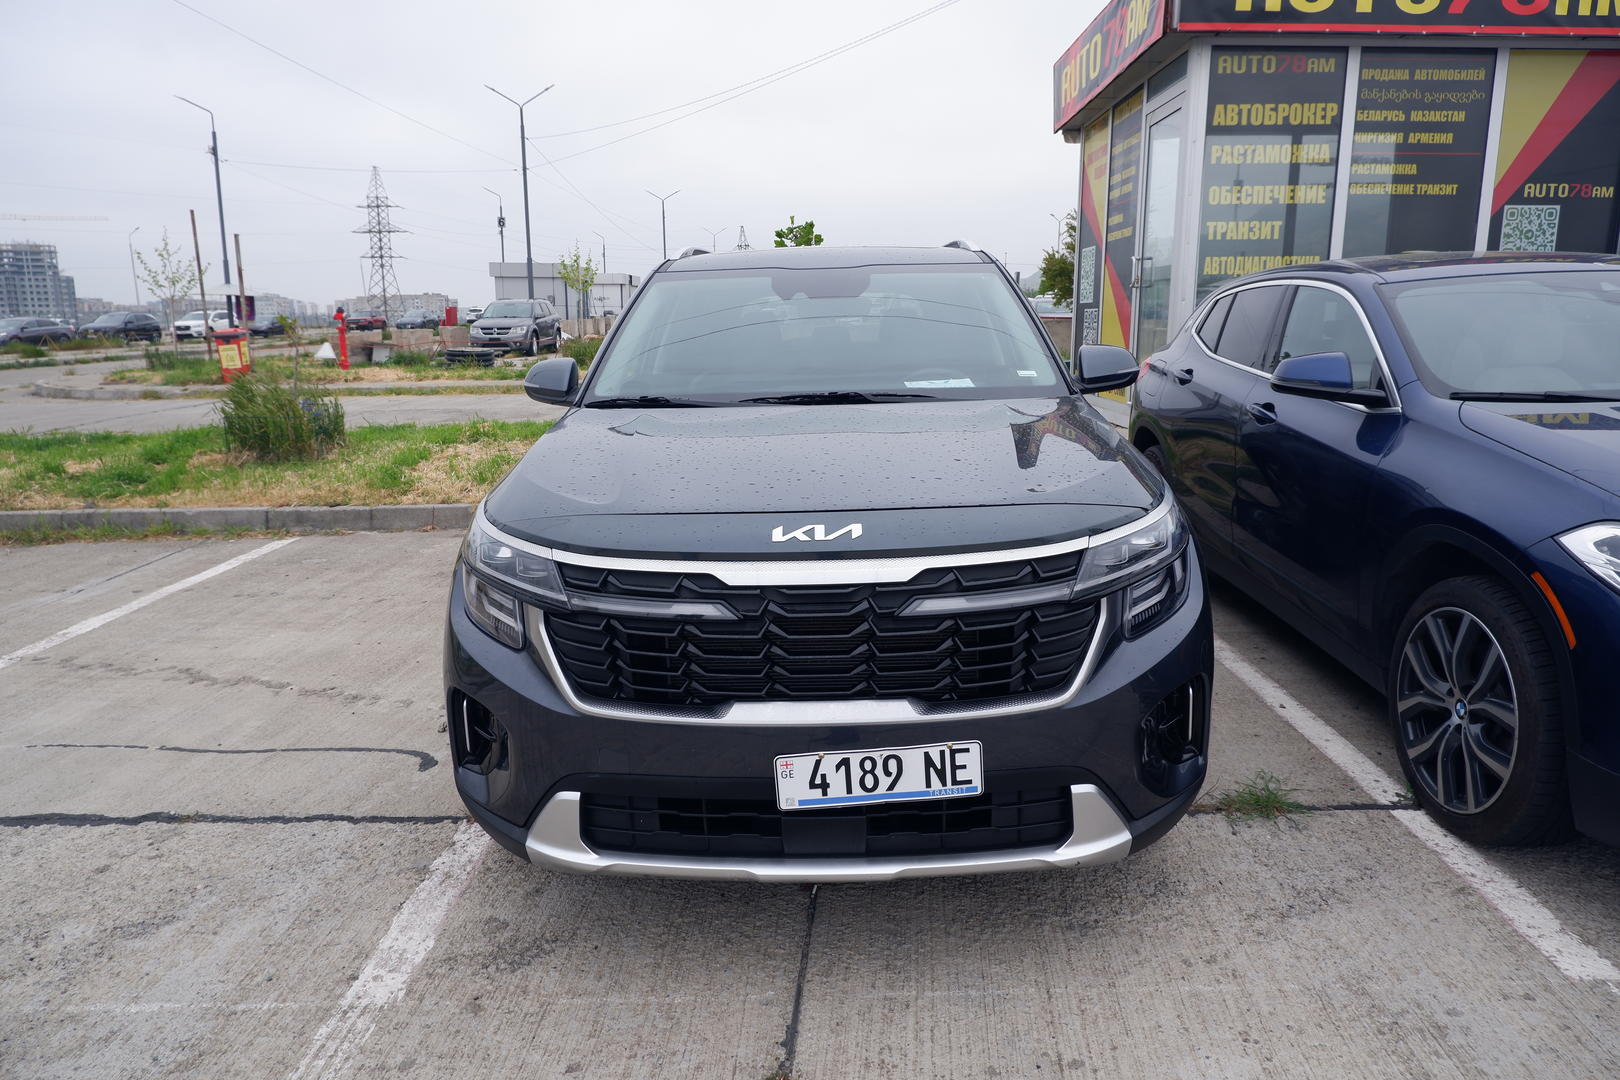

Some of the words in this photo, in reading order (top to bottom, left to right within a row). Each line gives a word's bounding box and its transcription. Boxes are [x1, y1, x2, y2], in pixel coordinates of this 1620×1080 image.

[1217, 54, 1336, 74] AUTO78AM
[1361, 68, 1410, 82] ПРОДАЖА
[1414, 68, 1486, 81] АВТОМОБИЛЕЙ
[1212, 103, 1338, 126] АВТОБРОКЕР
[1356, 110, 1405, 121] БЕЛАРУСЬ
[1410, 110, 1466, 122] КАЗАХСТАН
[1354, 132, 1404, 144] КИРГИЗИЯ
[1407, 132, 1454, 144] АРМЕНИЯ
[1211, 144, 1330, 165] РАСТАМОЖКА
[1351, 163, 1417, 175] РАСТАМОЖКА
[1208, 184, 1327, 205] ОБЕСПЕЧЕНИЕ
[1349, 183, 1415, 195] ОБЕСПЕЧЕНИЕ
[1416, 184, 1458, 195] ТРАНЗИТ
[1523, 183, 1615, 199] AUTO78AM
[1206, 221, 1282, 240] ТРАНЗИТ
[771, 523, 863, 542] KIA
[780, 769, 795, 780] GE
[808, 753, 904, 797] 4189
[923, 747, 973, 789] NE
[928, 787, 967, 797] TRANSIT
